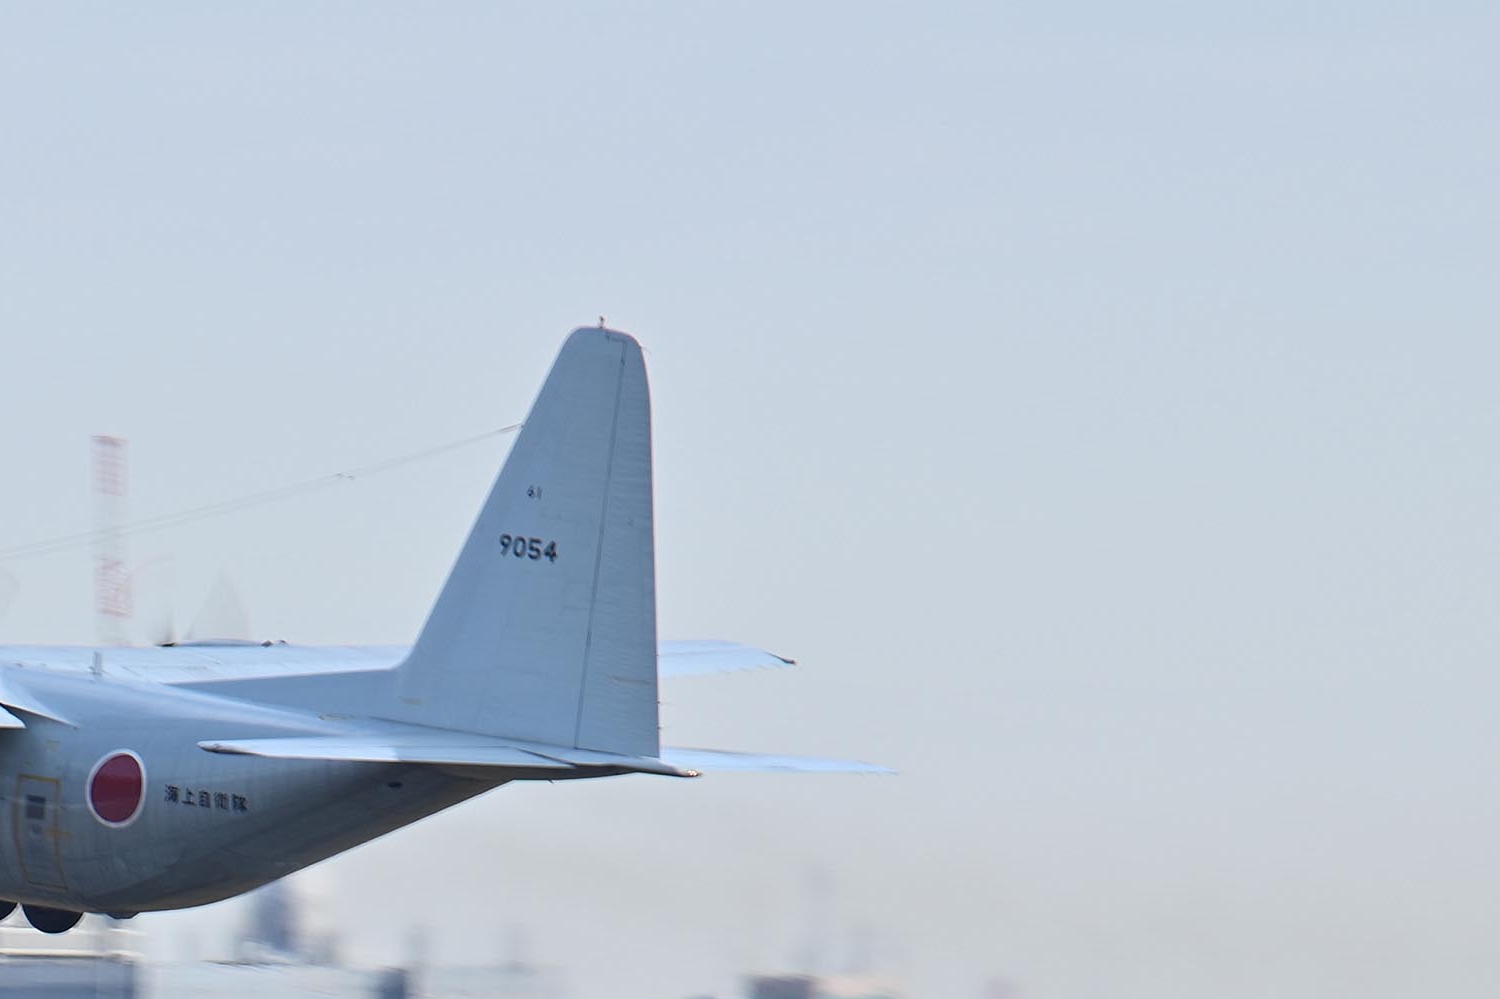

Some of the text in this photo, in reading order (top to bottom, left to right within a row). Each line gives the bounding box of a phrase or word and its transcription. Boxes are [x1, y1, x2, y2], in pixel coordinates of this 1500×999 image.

[500, 533, 557, 563] 9054
[164, 784, 247, 812] 海上自衛隊
